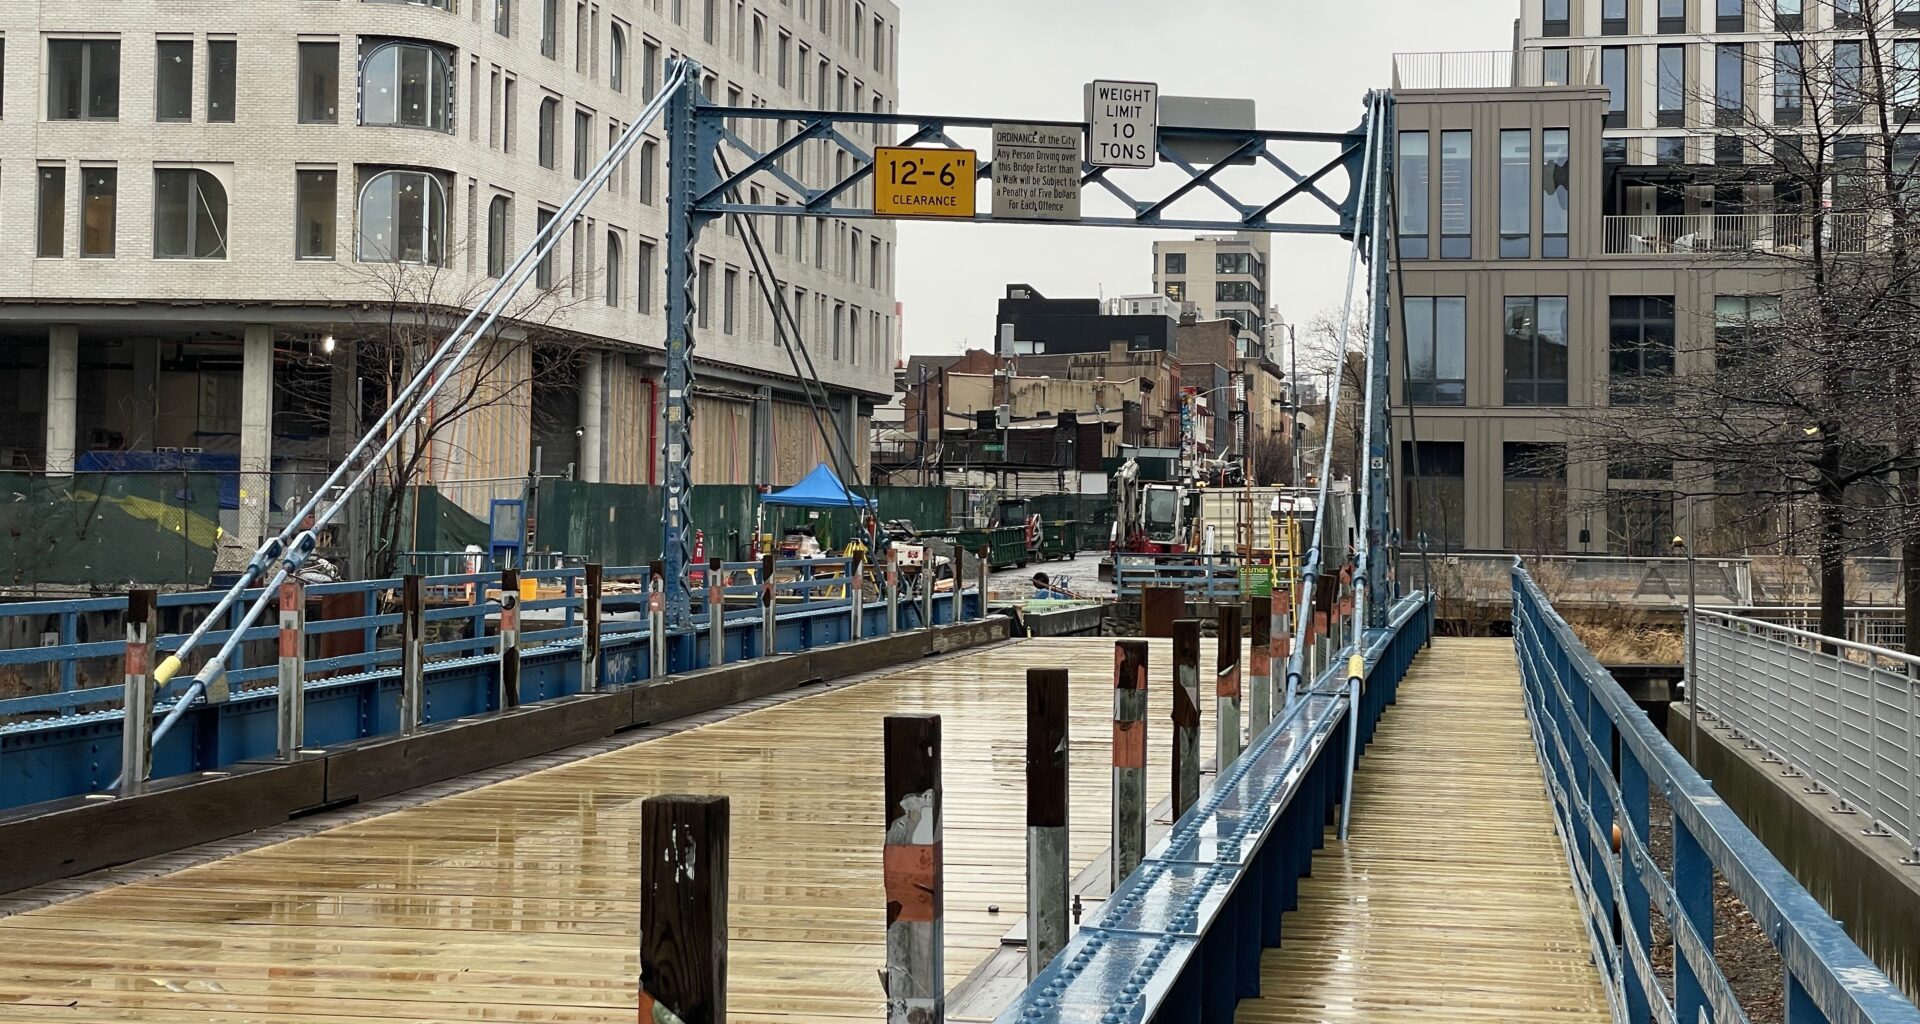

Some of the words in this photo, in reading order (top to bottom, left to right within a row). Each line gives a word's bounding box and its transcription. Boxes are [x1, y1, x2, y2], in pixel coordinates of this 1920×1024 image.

[1099, 88, 1151, 102] WEIGHT
[1106, 105, 1142, 118] LIMIT
[1113, 123, 1135, 138] 10
[996, 132, 1036, 144] ORDINANCE
[1039, 136, 1046, 144] of
[1048, 136, 1060, 144] the
[1061, 135, 1076, 147] City
[997, 149, 1010, 160] Any
[1012, 150, 1034, 159] Person
[1037, 150, 1060, 162] Driving
[1061, 153, 1076, 161] over
[1100, 143, 1146, 159] TONS
[890, 158, 965, 186] 12'-6"
[998, 162, 1011, 171] this
[1013, 162, 1034, 174] Bridge
[1036, 164, 1056, 173] Faster
[1058, 164, 1074, 174] than
[1003, 175, 1017, 184] Walk
[1020, 176, 1030, 185] will
[1033, 176, 1040, 185] be
[1042, 176, 1067, 188] Subject
[1069, 178, 1077, 187] to
[892, 194, 957, 207] CLEARANCE
[996, 189, 1001, 197] a
[1003, 188, 1028, 199] Penalty
[1030, 189, 1037, 197] of
[1038, 189, 1052, 198] Five
[1054, 189, 1076, 200] Dollars
[1008, 200, 1019, 209] For
[1021, 200, 1036, 210] Each
